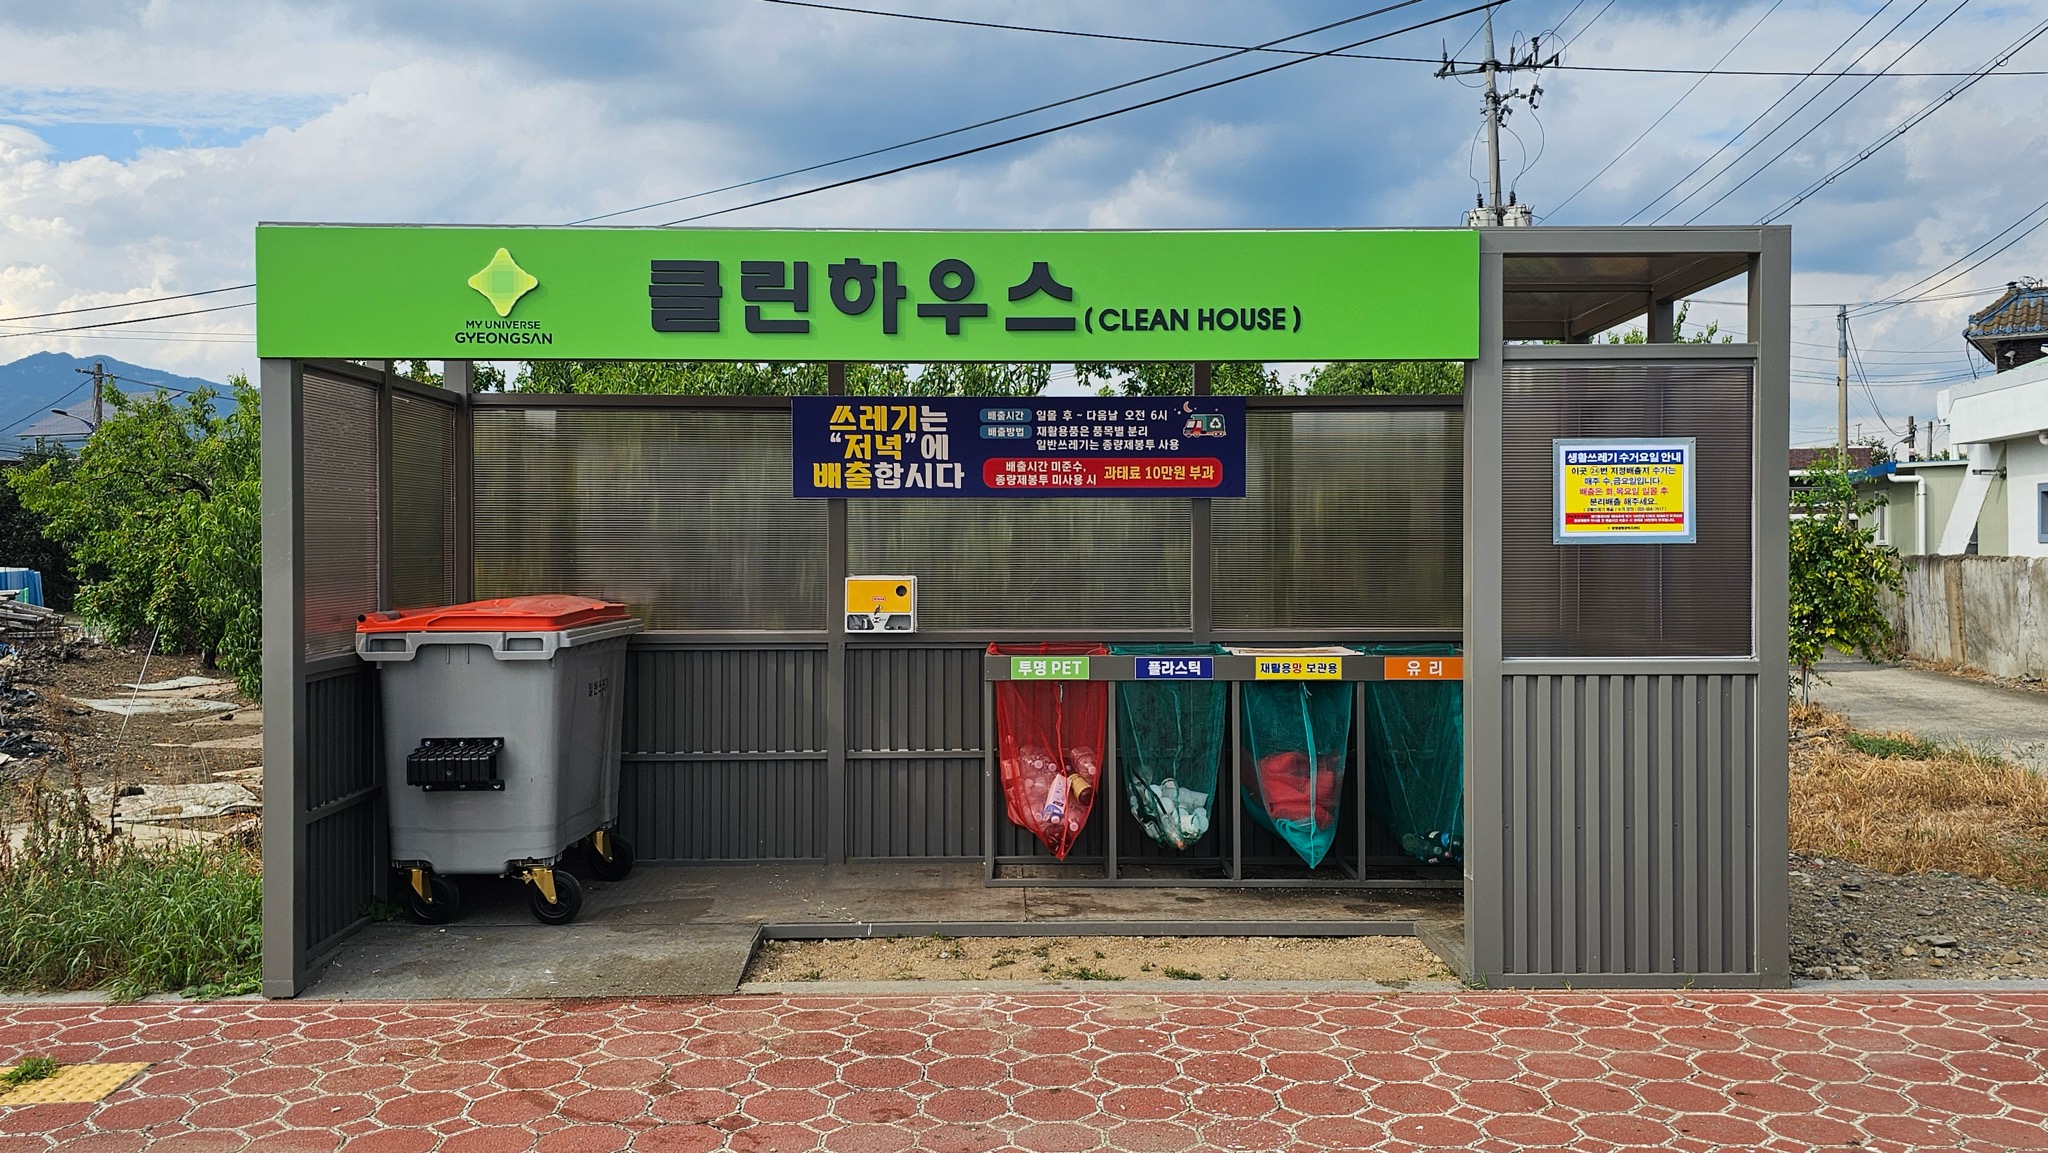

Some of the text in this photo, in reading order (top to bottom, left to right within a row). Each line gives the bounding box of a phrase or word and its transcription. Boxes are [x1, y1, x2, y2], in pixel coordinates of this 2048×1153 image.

[649, 258, 1076, 336] 클린하우스
[466, 321, 541, 329] MY UNIVERSE
[455, 332, 553, 345] GYEONGSAN
[829, 405, 948, 432] 쓰레기는
[987, 410, 1024, 421] 배출시간
[1036, 410, 1058, 421] 일몰
[1062, 410, 1073, 421] 후
[1086, 410, 1117, 421] 다음날
[1124, 410, 1145, 421] 오전
[1150, 410, 1168, 421] 6시
[987, 427, 1024, 437] 배출방법
[1036, 426, 1148, 437] 재활용품은 품목별 분리
[1036, 439, 1180, 450] 일반쓰레기는 종량제봉투 사용
[1567, 452, 1681, 463] 생활쓰레기 수거요일 안내
[1005, 461, 1086, 473] 배출시간 미준수,
[1103, 465, 1214, 480] 과태료 10만원 부과
[1571, 467, 1587, 475] 이곳
[812, 461, 965, 489] 배출합시다
[995, 474, 1097, 486] 종량제봉투 미사용 시
[1017, 660, 1082, 676] 투명 PET
[1147, 660, 1202, 676] 플라스틱
[1260, 662, 1338, 675] 재활용망 보관용
